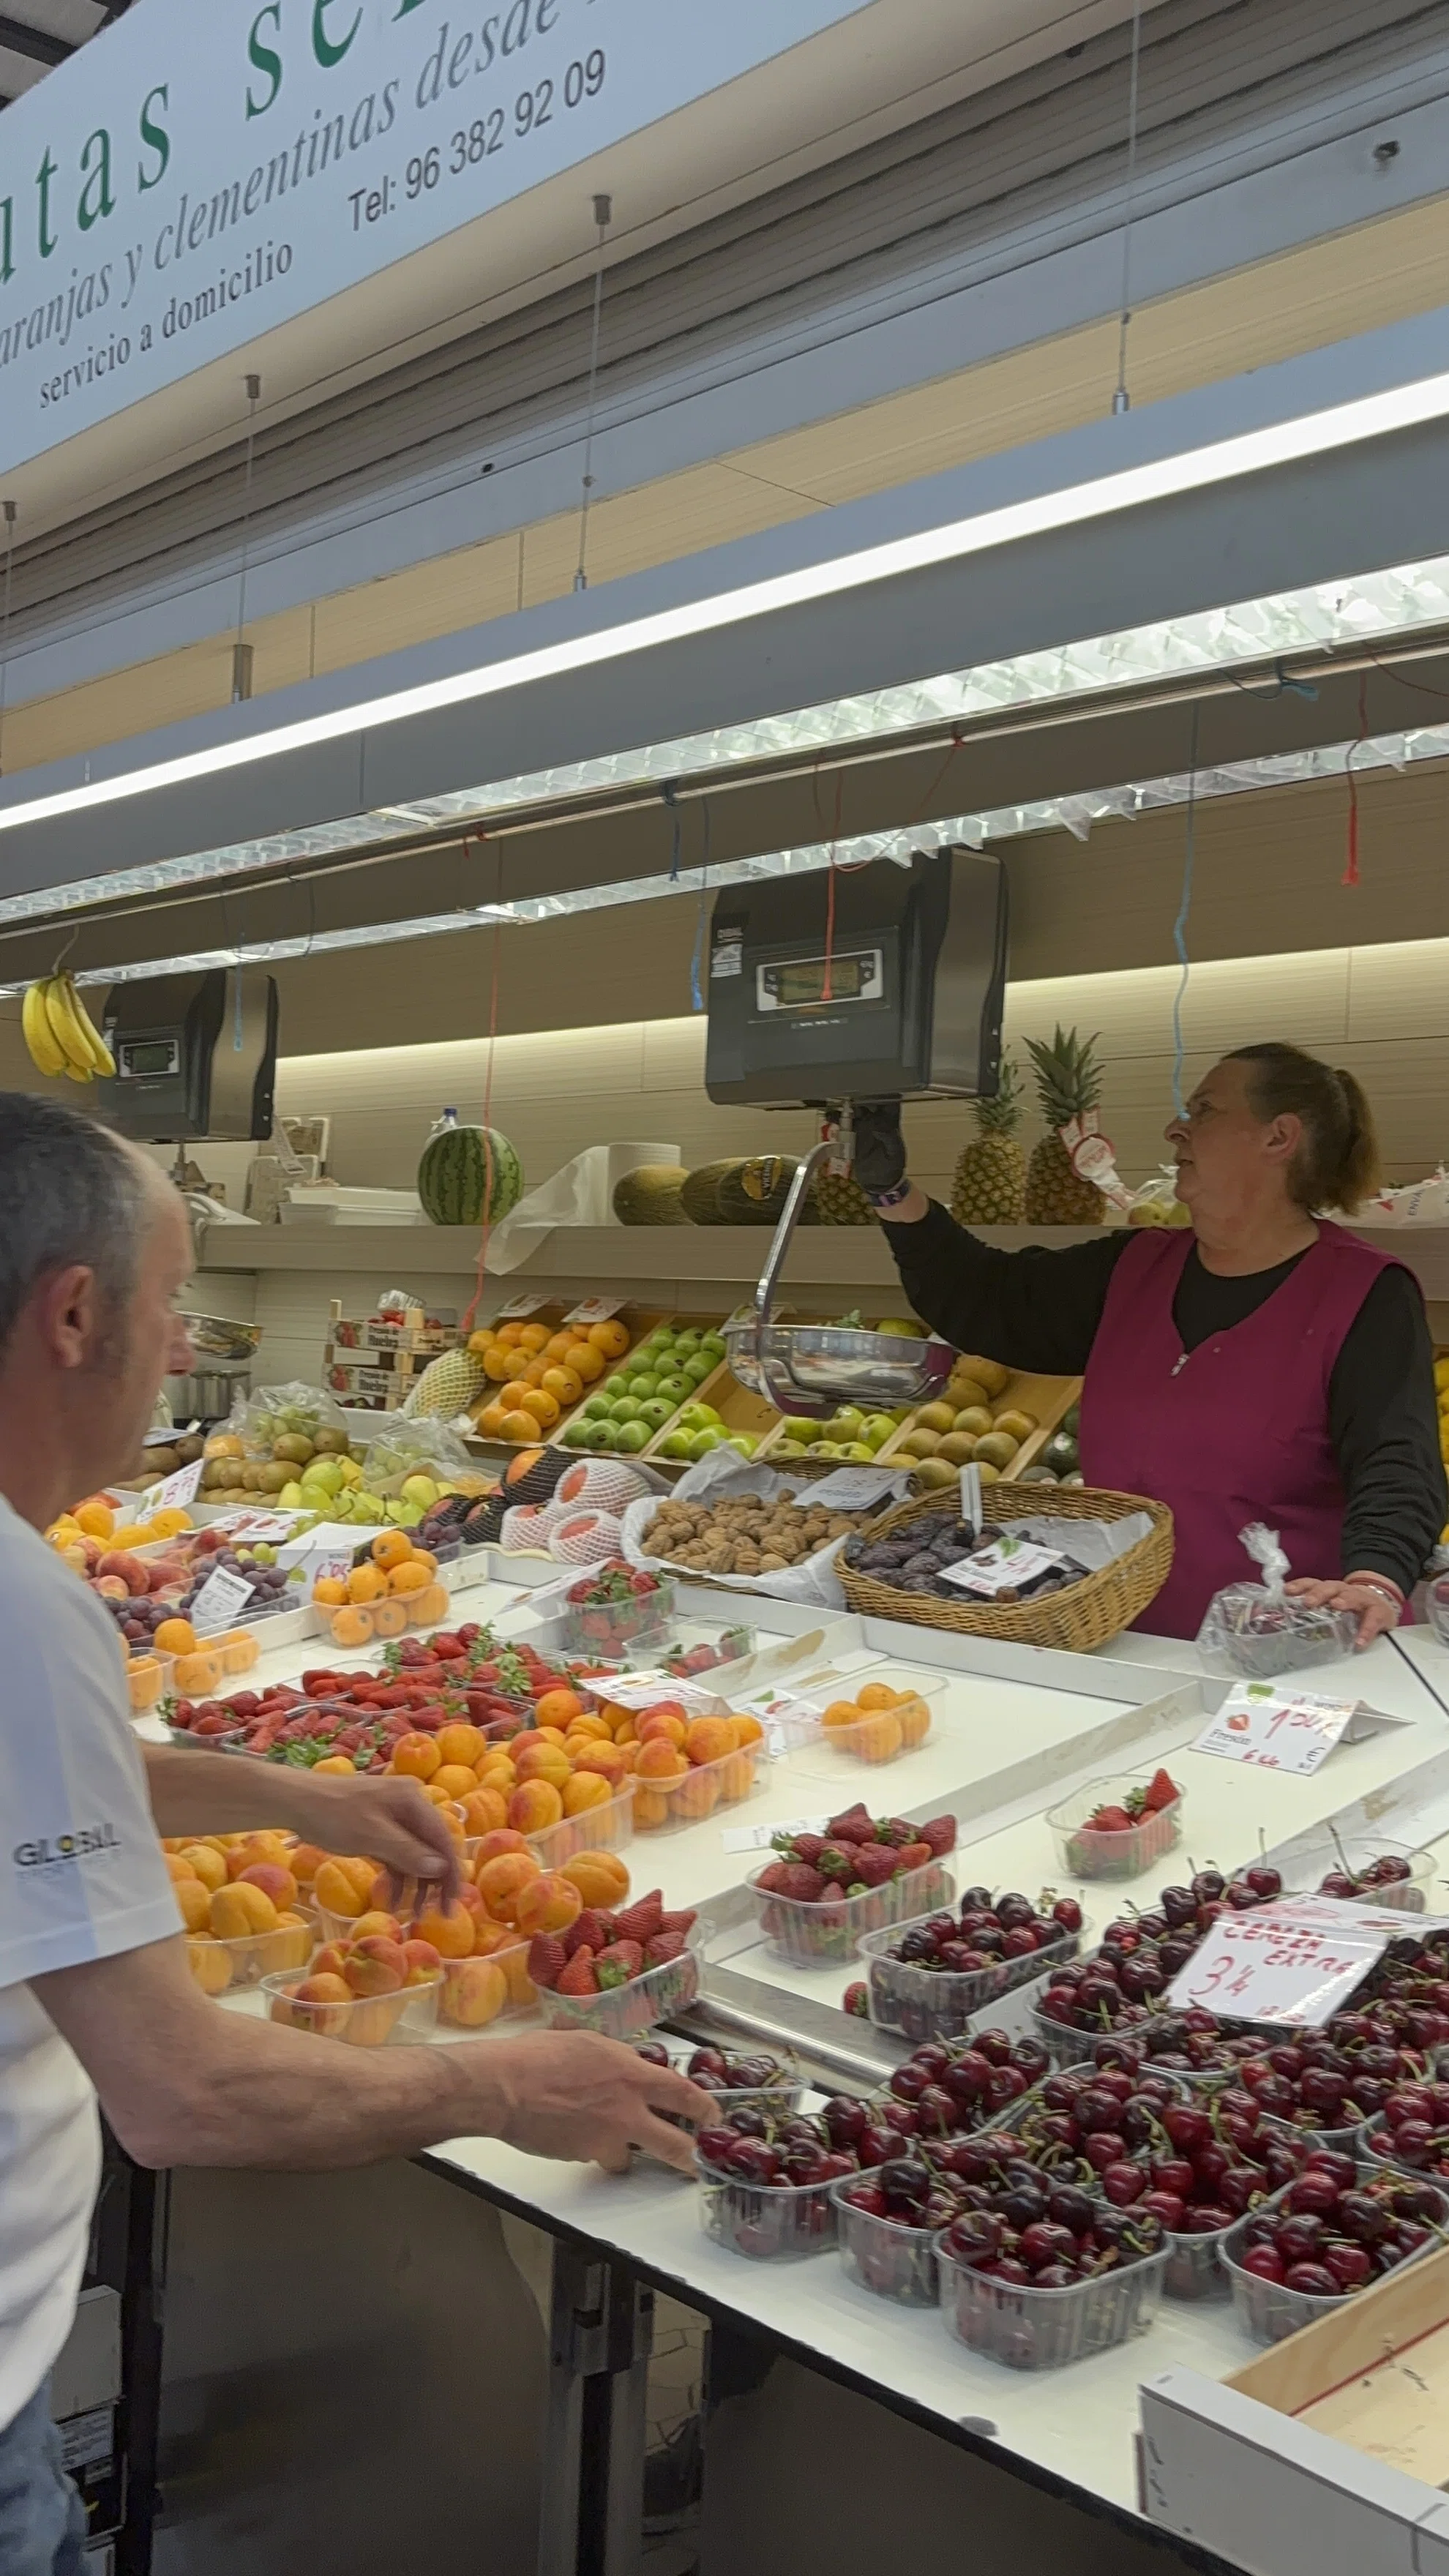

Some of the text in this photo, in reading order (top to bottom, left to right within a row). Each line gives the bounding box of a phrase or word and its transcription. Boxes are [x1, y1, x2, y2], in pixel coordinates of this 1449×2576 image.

[245, 0, 425, 121] se
[348, 49, 605, 231] Tel: 96 382 92 09
[121, 244, 143, 309] y
[154, 78, 400, 270] clementinas
[416, 0, 561, 109] desde
[40, 240, 293, 408] servicio a domicilio
